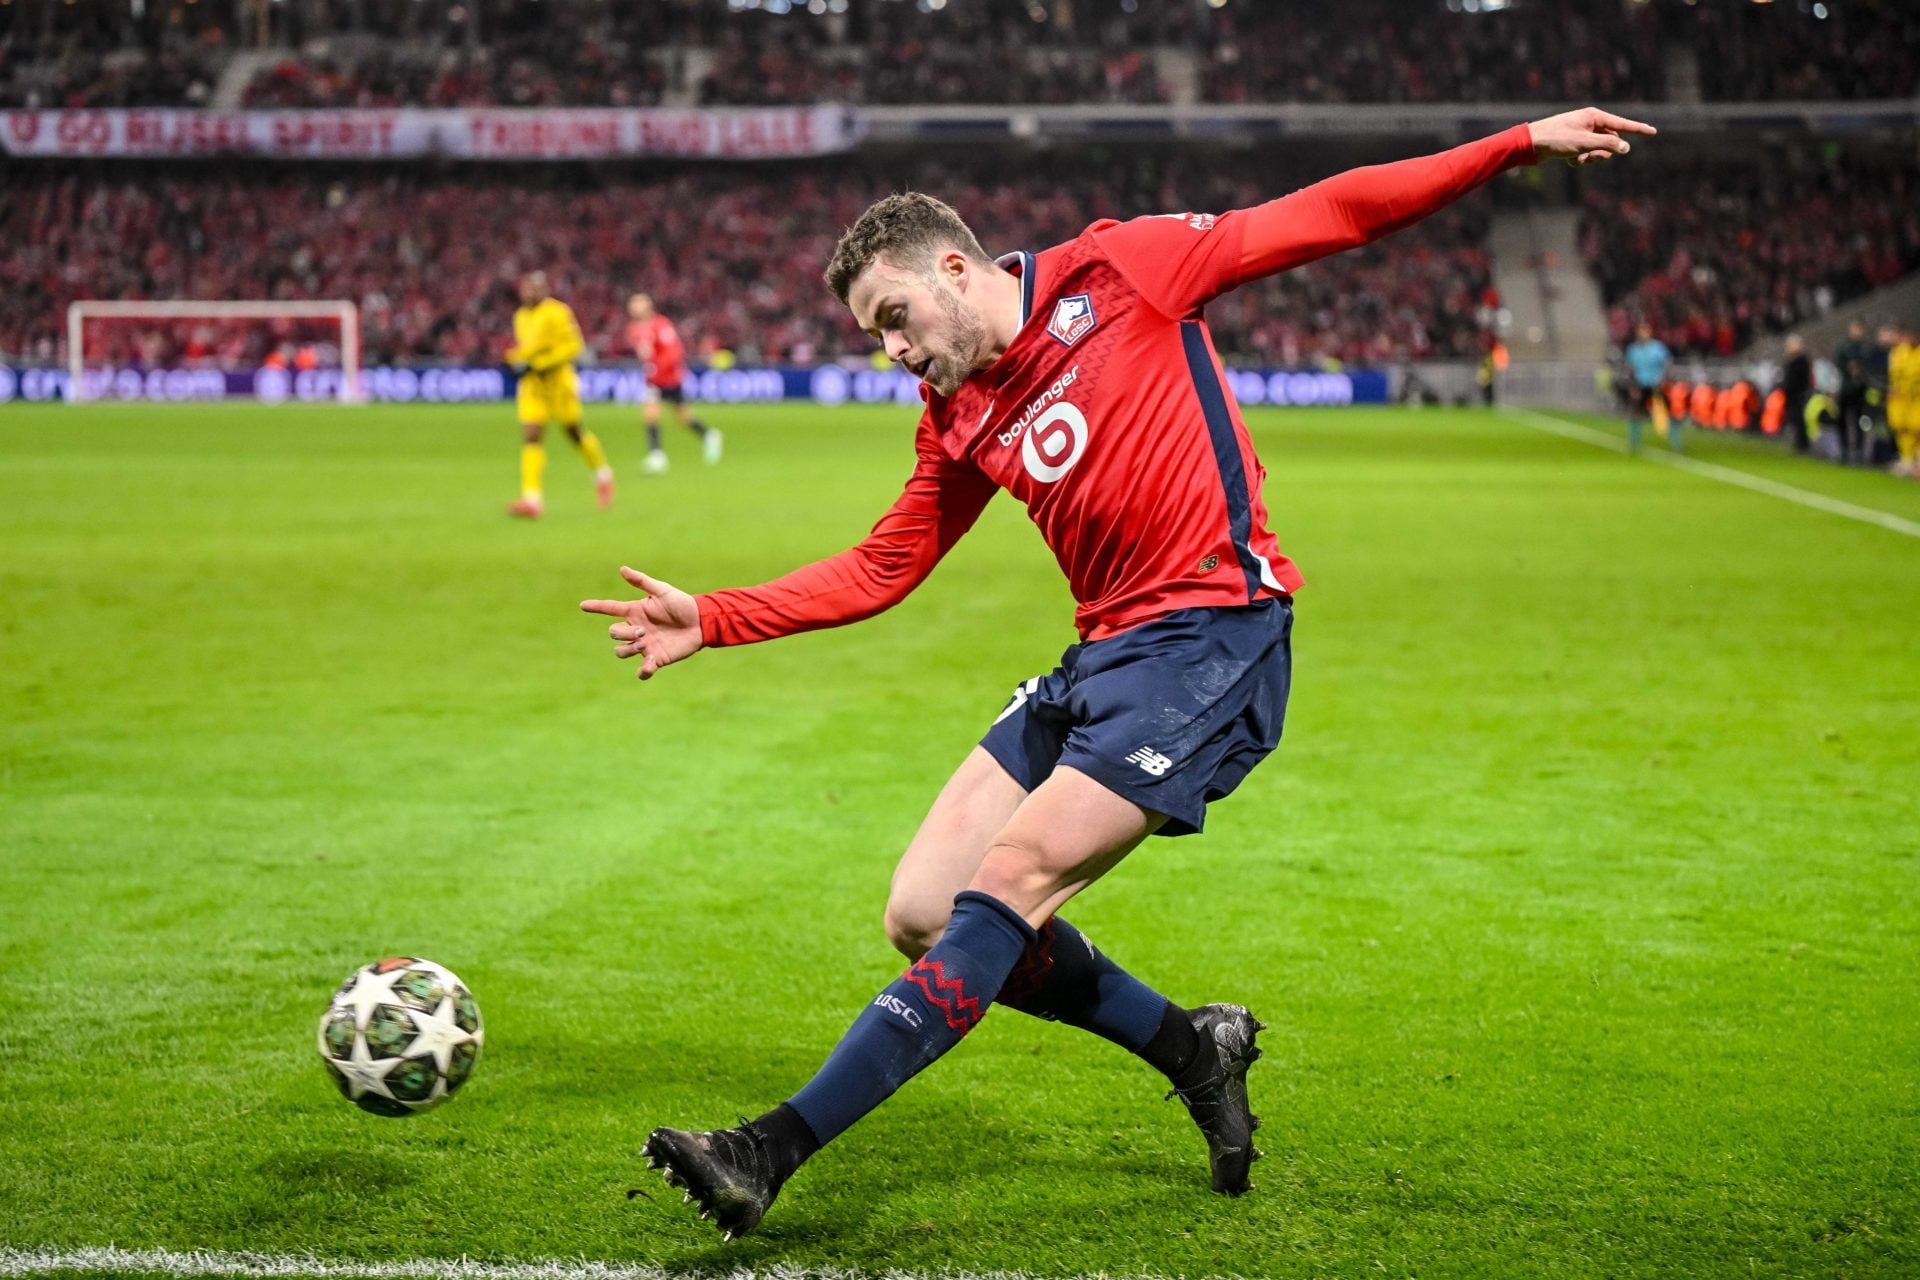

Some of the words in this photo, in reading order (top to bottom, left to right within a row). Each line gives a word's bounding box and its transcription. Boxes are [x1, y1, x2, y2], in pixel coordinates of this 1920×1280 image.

[1066, 317, 1091, 342] LOSC
[997, 364, 1079, 448] boulanger
[874, 993, 923, 1028] LOSC
